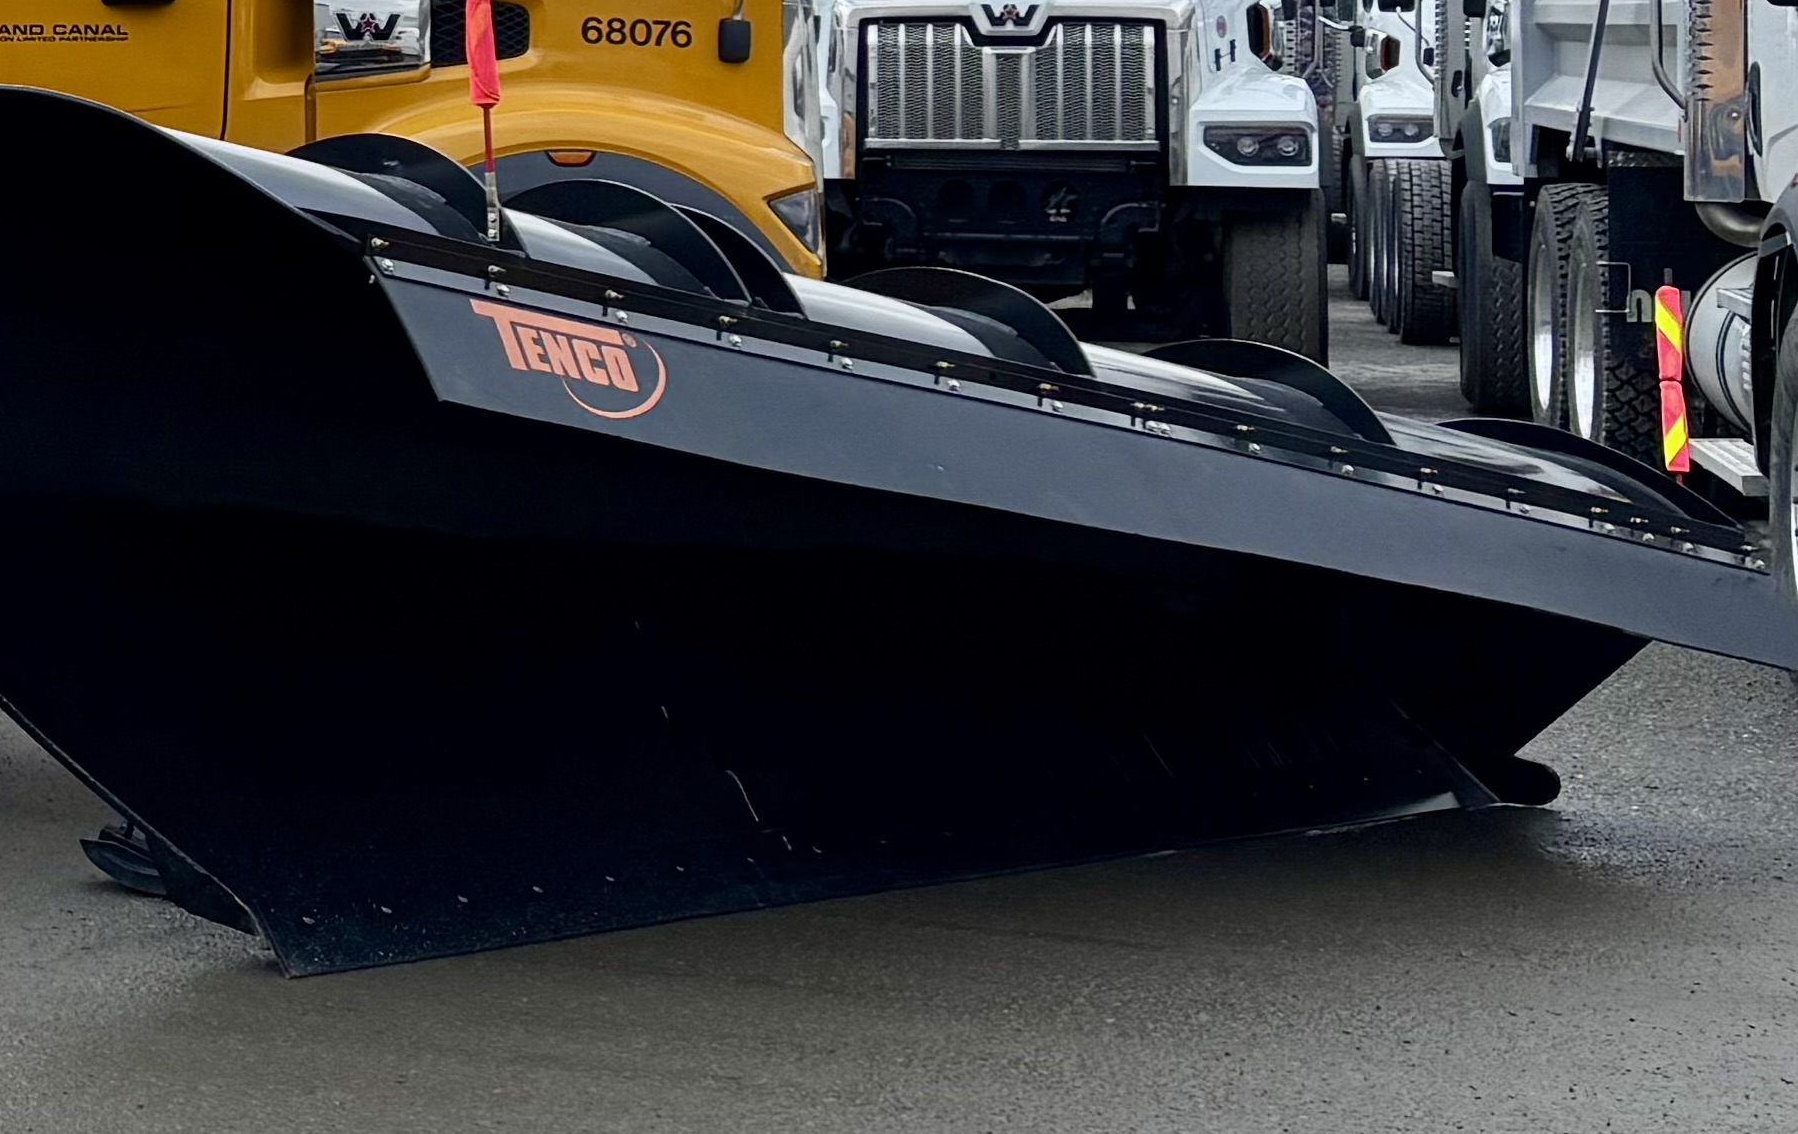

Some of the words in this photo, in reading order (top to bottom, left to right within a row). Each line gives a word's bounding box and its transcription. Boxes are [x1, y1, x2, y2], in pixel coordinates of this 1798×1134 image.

[52, 24, 129, 36] CANAL
[581, 16, 692, 48] 68076
[469, 298, 640, 393] TENCO
